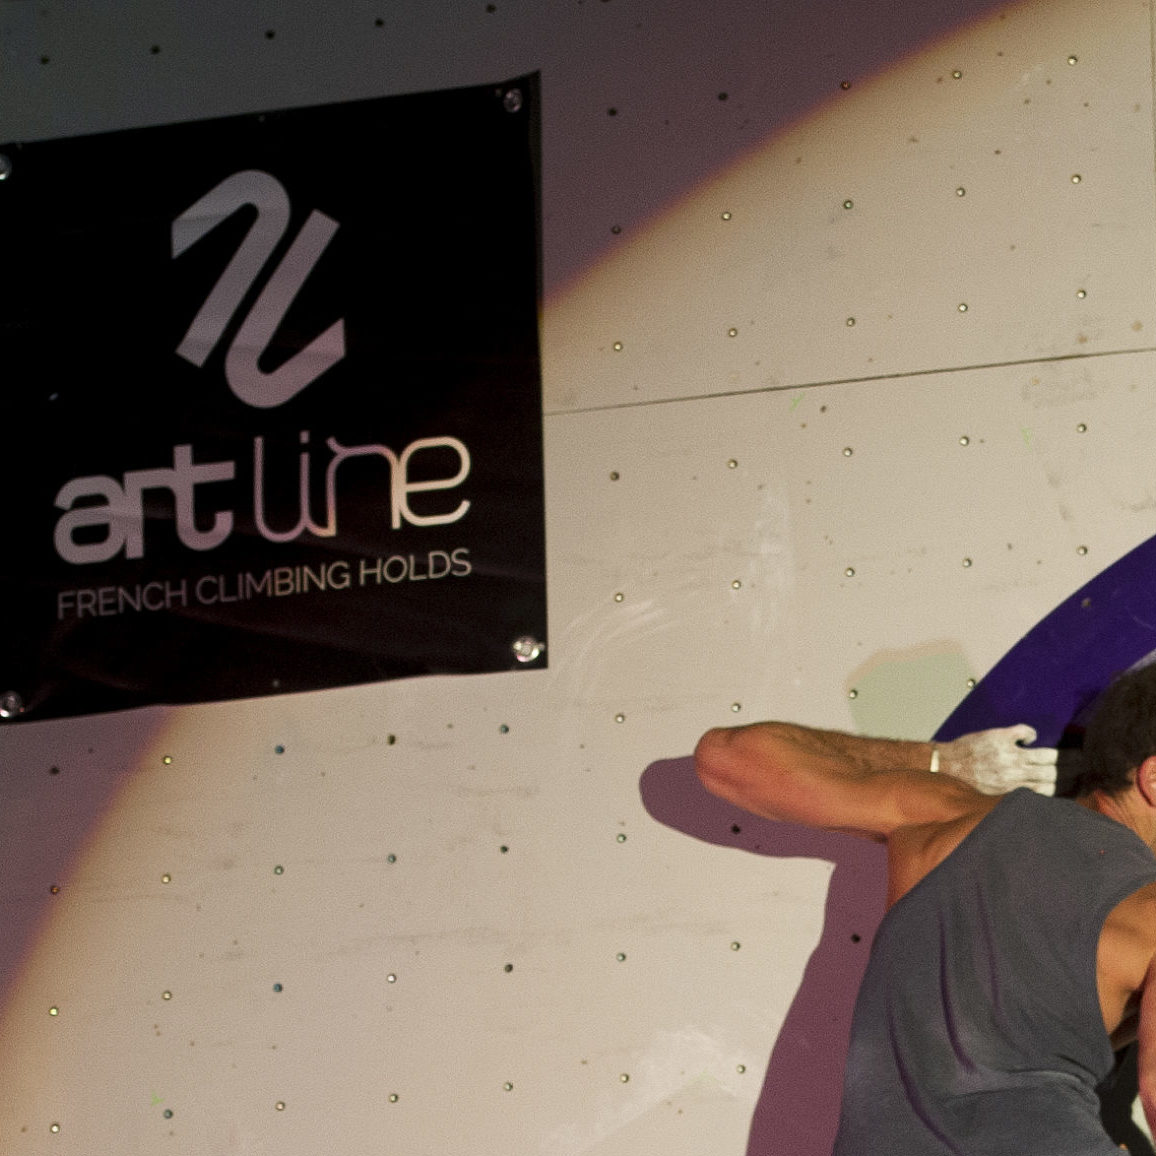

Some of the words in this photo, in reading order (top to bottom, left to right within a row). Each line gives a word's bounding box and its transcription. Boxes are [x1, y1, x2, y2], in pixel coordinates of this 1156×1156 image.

[57, 578, 187, 621] FRENCH
[195, 560, 350, 605] CLIMBING
[359, 547, 472, 587] HOLDS
